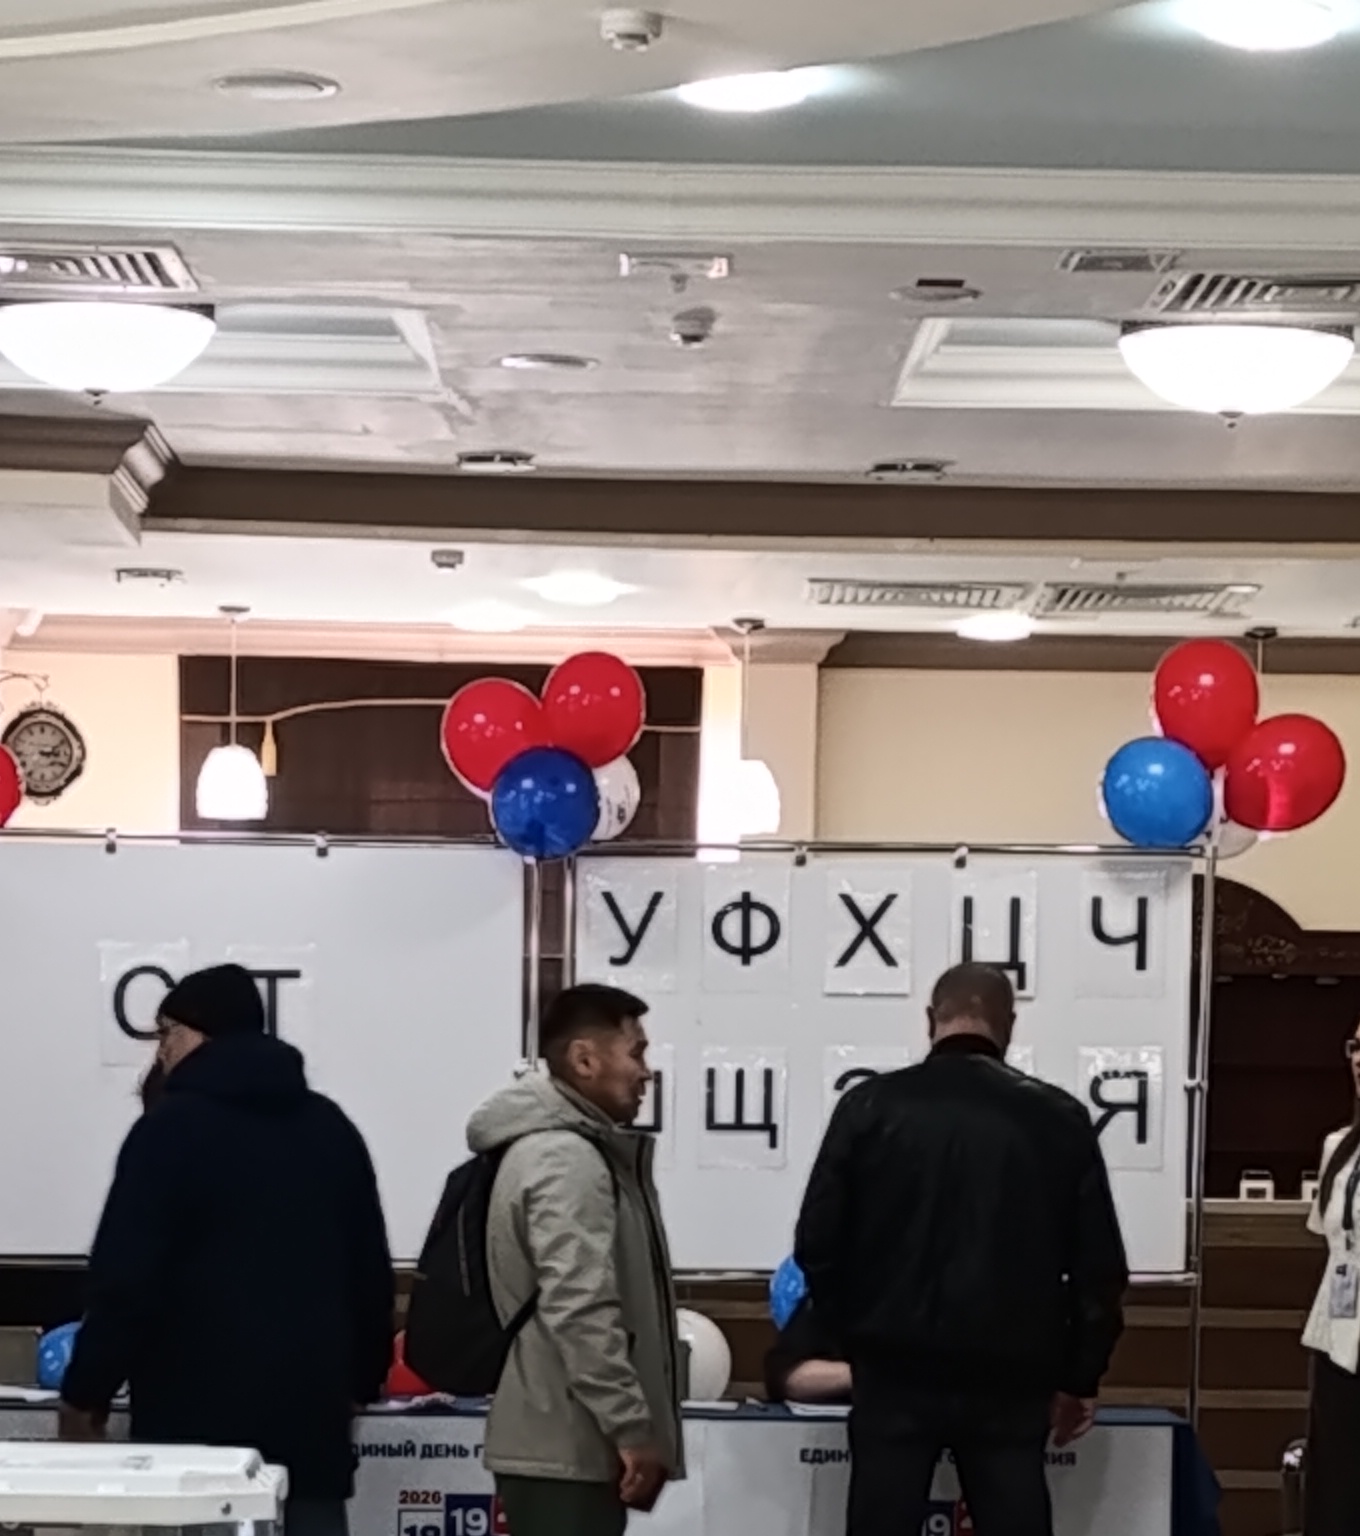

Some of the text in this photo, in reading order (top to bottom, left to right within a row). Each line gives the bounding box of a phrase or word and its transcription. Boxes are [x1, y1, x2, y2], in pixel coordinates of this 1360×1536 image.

[601, 890, 1147, 990] У Ф Х Ц Ч
[706, 1067, 778, 1149] Щ
[1087, 1070, 1148, 1144] Я
[419, 1442, 470, 1460] ДЕНЬ
[399, 1489, 443, 1505] 2026
